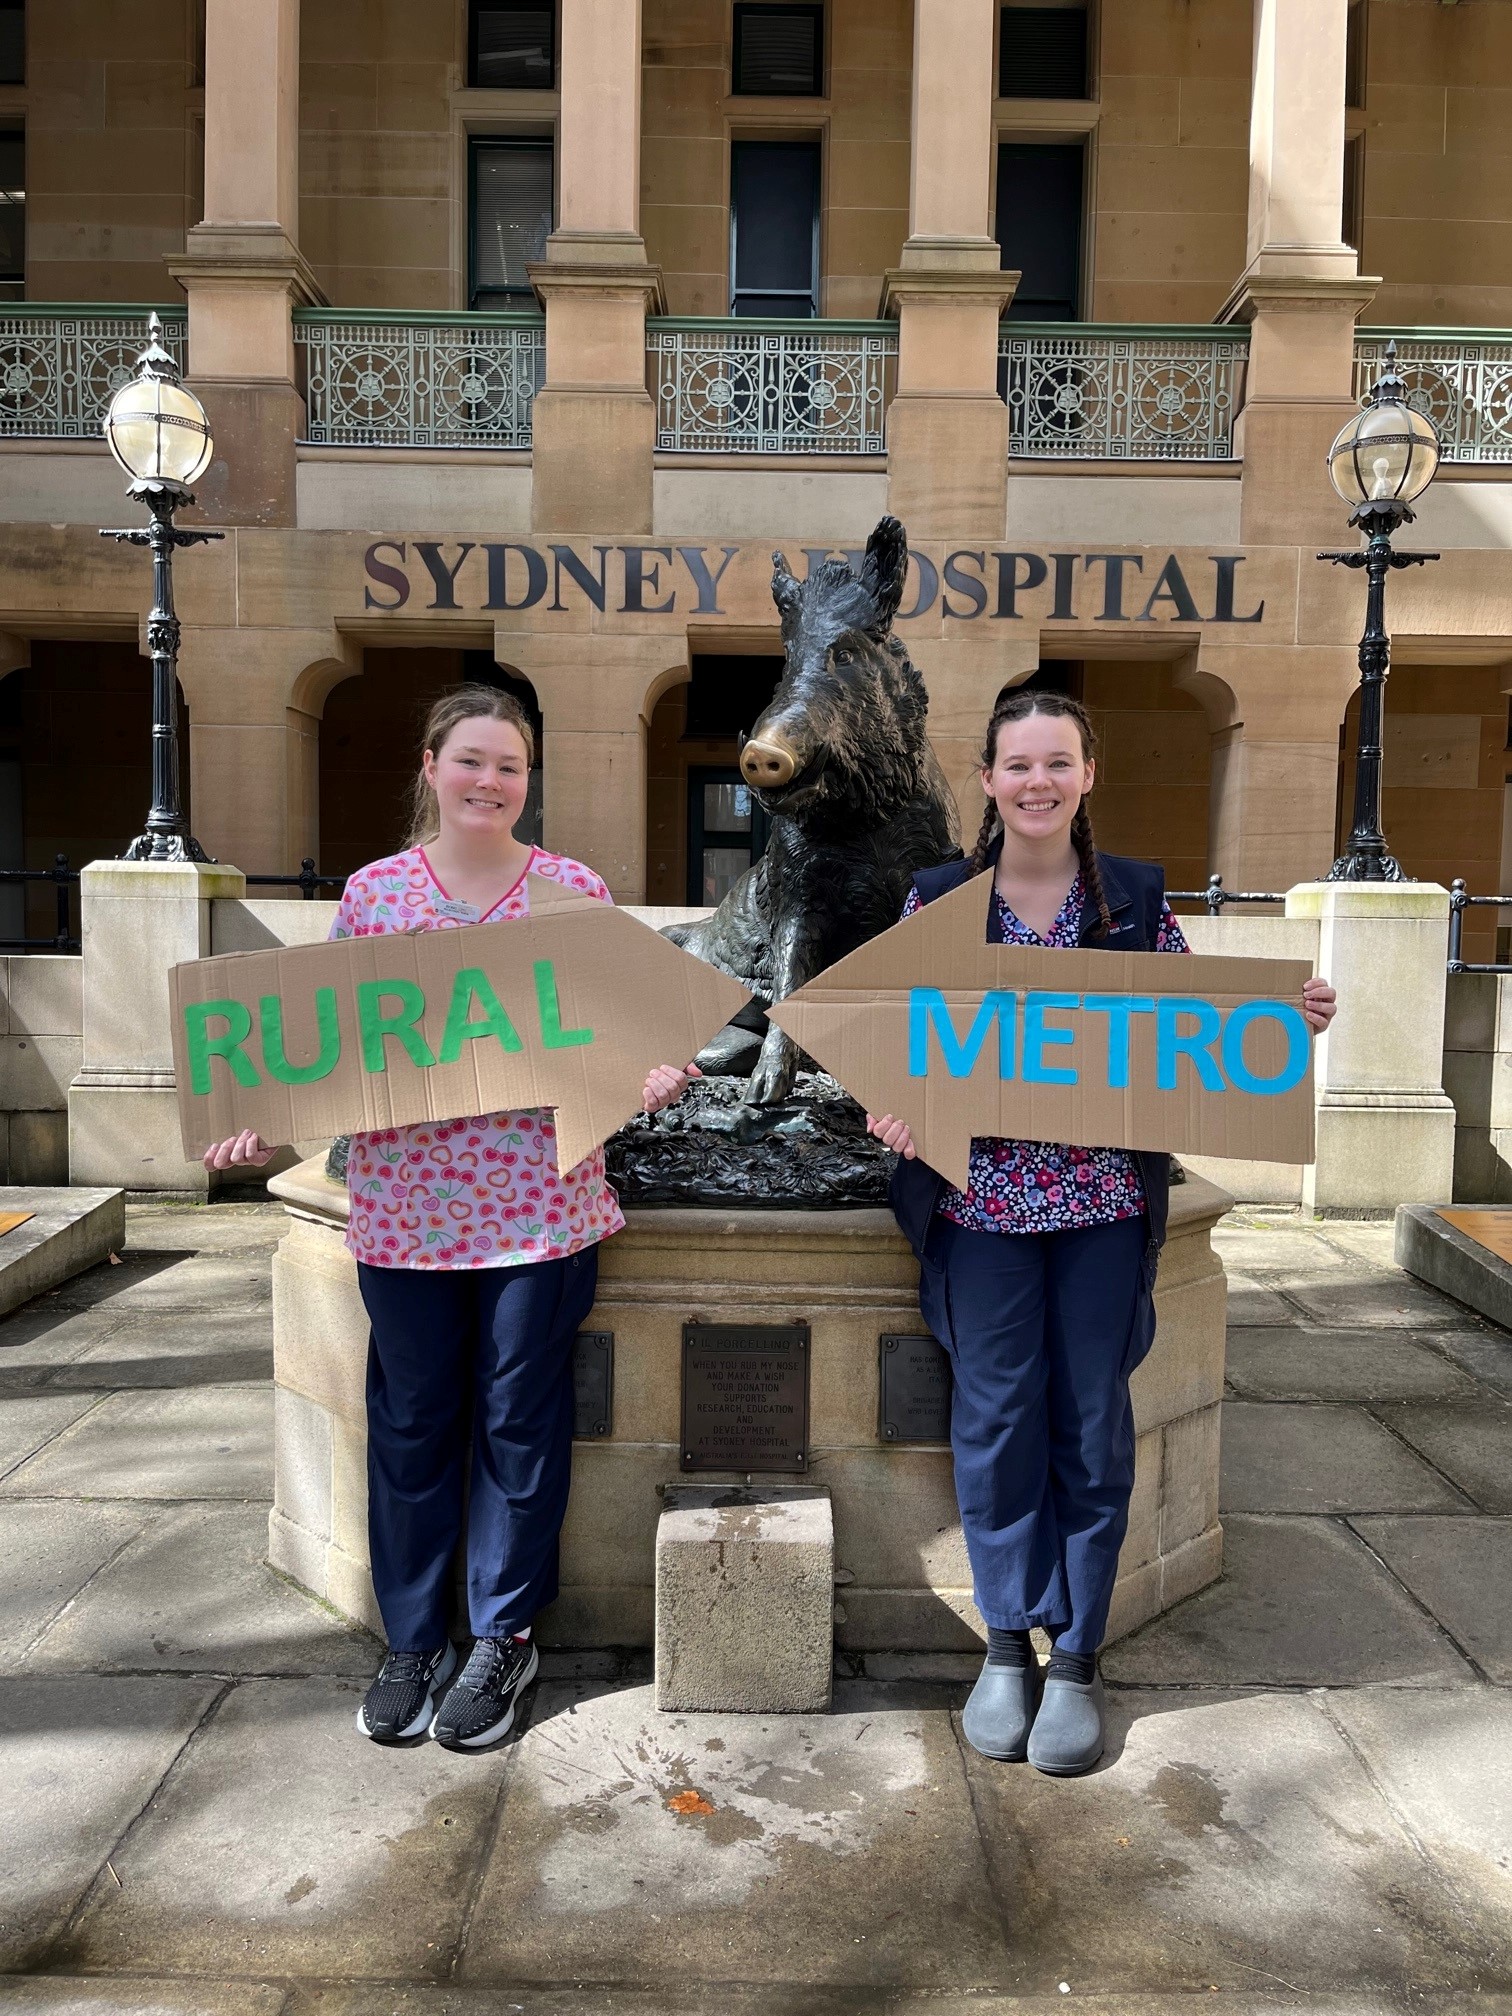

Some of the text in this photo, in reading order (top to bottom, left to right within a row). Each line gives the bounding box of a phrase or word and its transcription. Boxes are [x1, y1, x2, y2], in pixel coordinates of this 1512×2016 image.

[364, 541, 740, 614] SYDNEY
[184, 959, 595, 1096] RURAL
[908, 986, 1311, 1096] METRO
[701, 1338, 790, 1350] IL PORCELLINO
[692, 1361, 800, 1371] WHEN YOU RUB MY NOSE
[706, 1371, 785, 1381] AND MAKE A WISH
[711, 1382, 779, 1393] YOUR DONATION
[723, 1393, 767, 1403] SUPPORTS
[697, 1403, 794, 1414] RESEARCH, EDUCATION
[736, 1415, 754, 1424] AND
[713, 1425, 776, 1436] DEVELOPMENT
[698, 1437, 790, 1447] AT SYDNEY HOSPITAL
[759, 1452, 788, 1460] HOSPITAL
